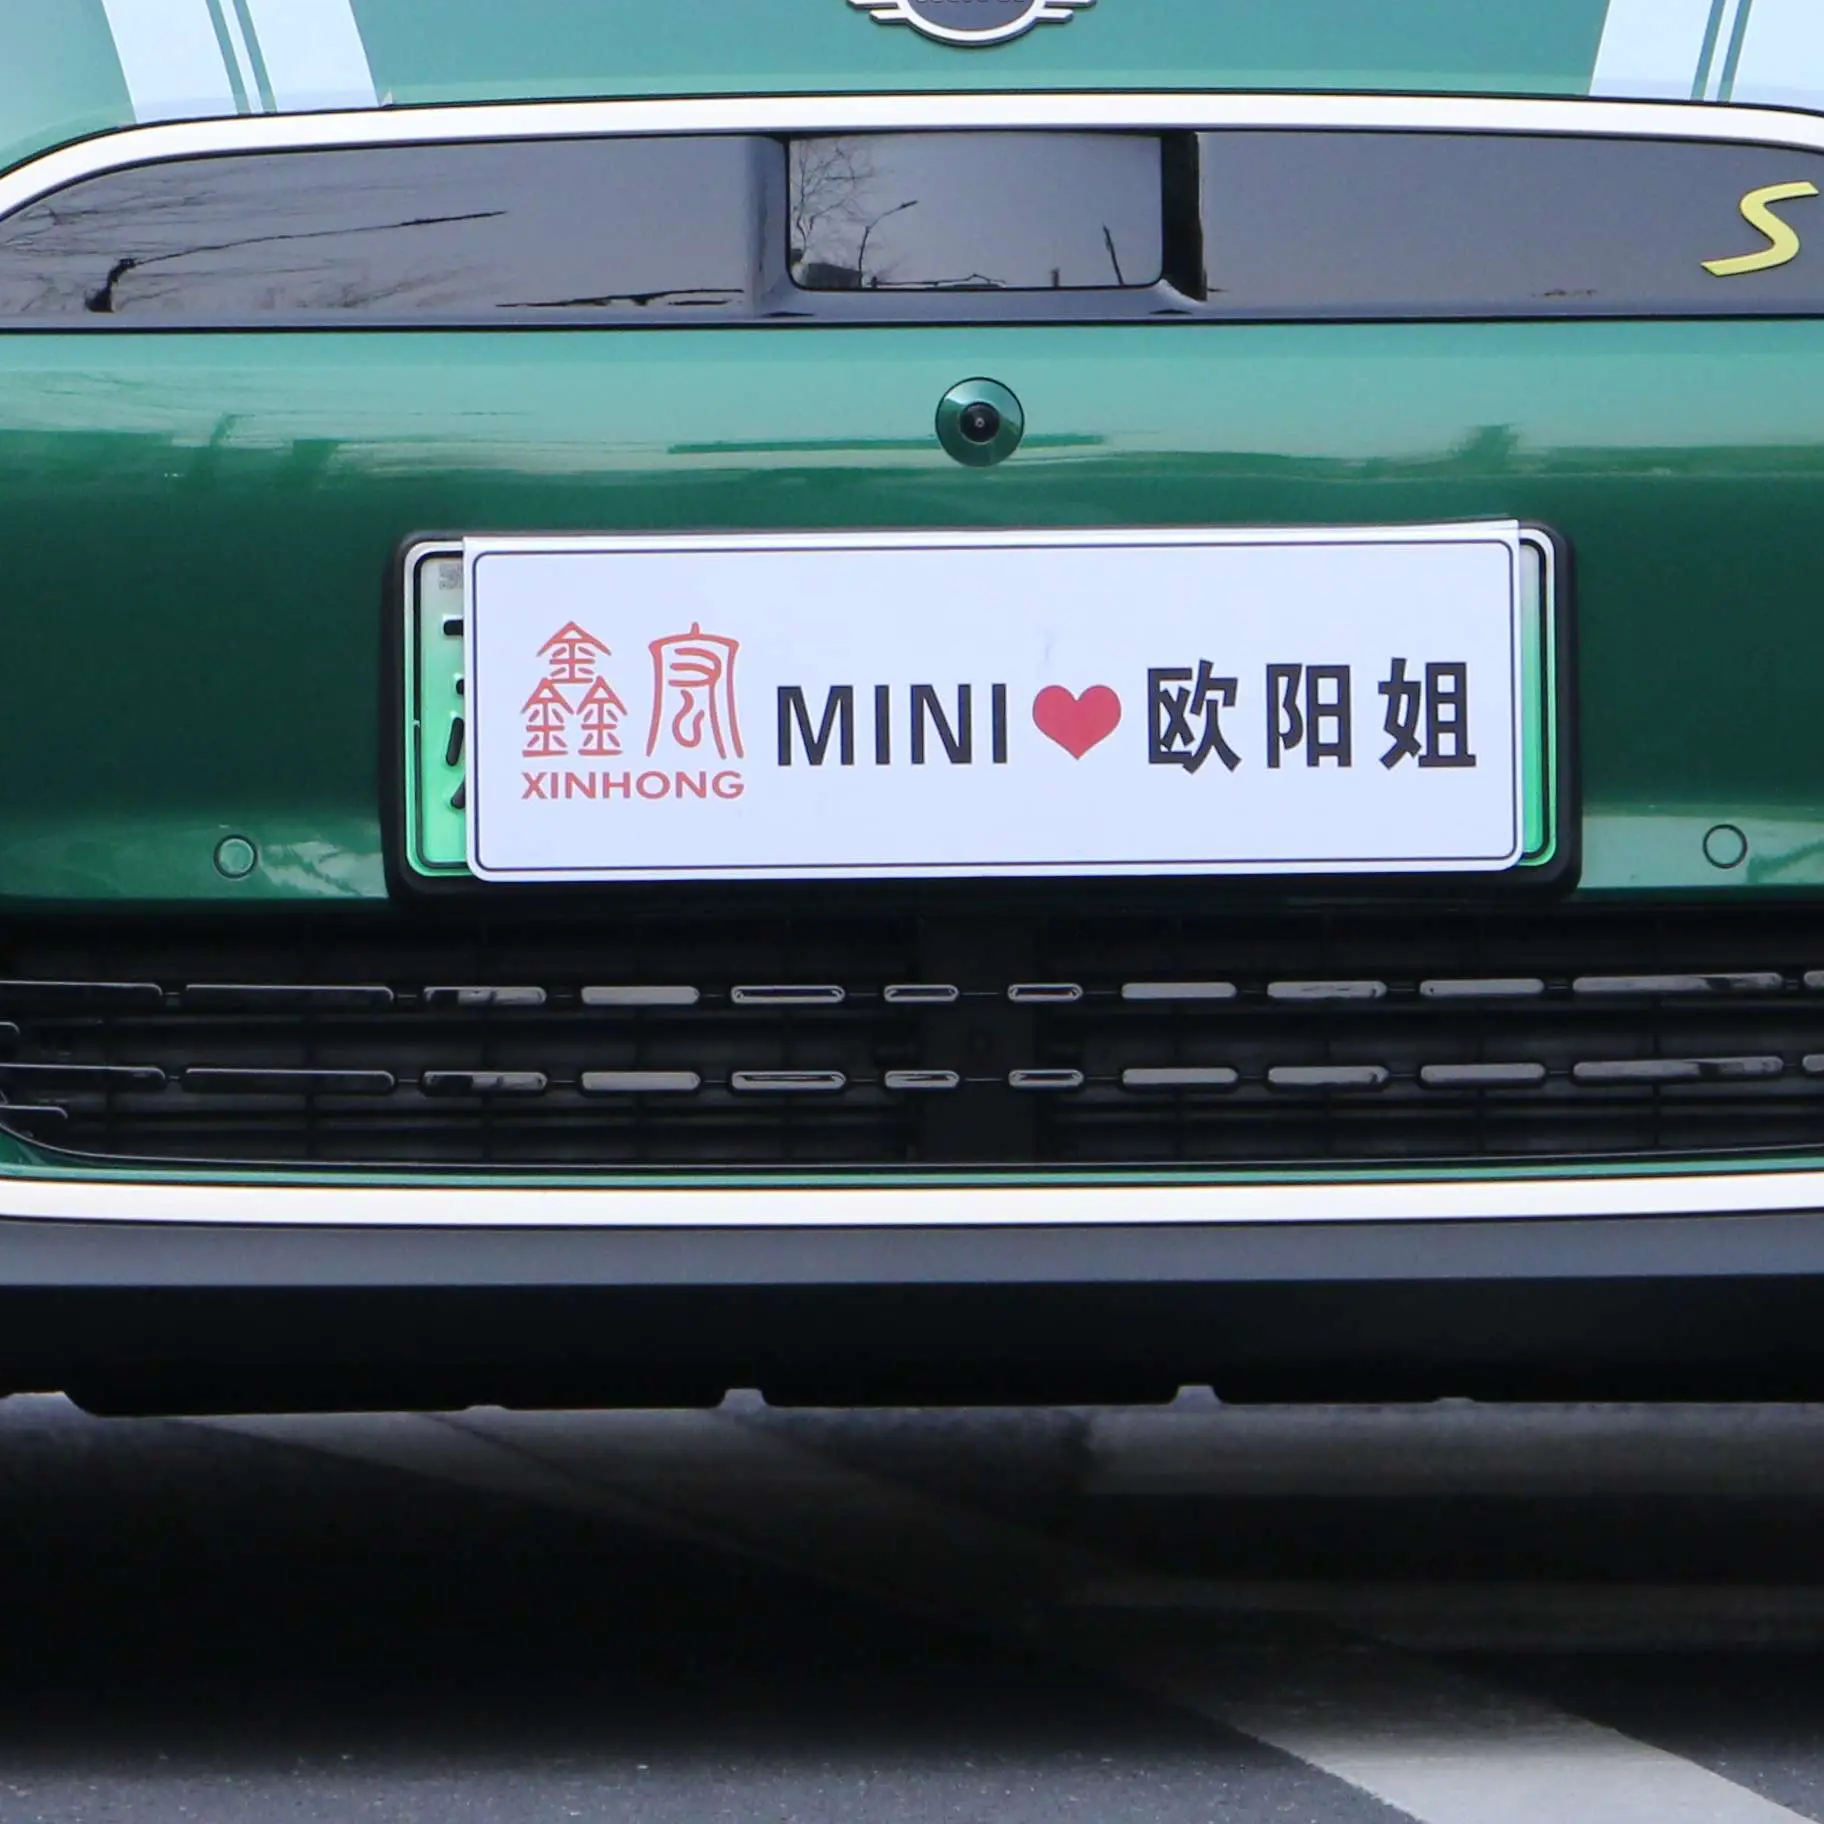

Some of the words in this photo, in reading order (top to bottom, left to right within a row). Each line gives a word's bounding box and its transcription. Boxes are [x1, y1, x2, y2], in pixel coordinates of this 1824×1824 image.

[1700, 180, 1819, 277] S
[777, 683, 1008, 766] MINI
[1147, 657, 1477, 774] 欧阳姐
[521, 770, 745, 800] XINHONG
